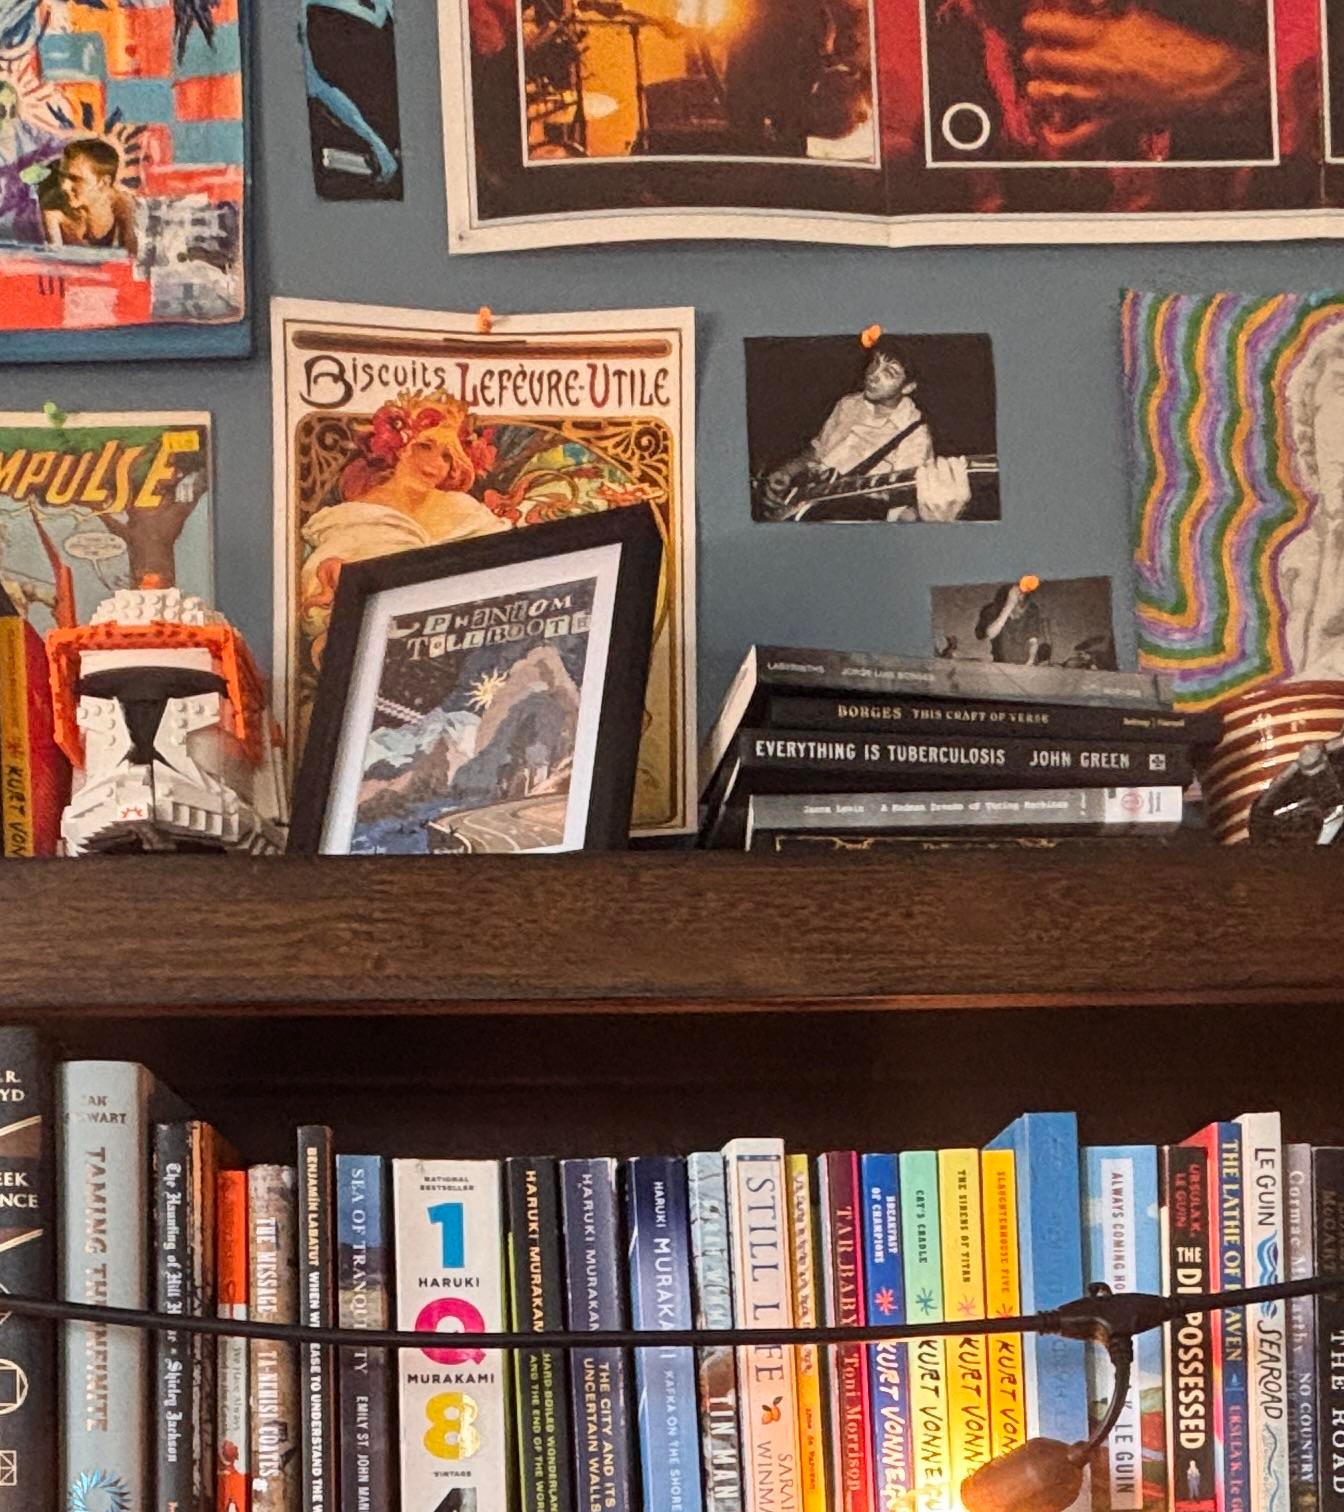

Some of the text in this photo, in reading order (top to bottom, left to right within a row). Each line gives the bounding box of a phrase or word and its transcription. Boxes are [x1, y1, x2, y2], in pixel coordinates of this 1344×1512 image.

[838, 703, 904, 722] BORGES
[913, 709, 943, 721] THIS
[990, 712, 1007, 723] OF
[755, 740, 1132, 769] EVERYTHING IS TUBERCULOSIS JOHN GREEN
[427, 1202, 466, 1269] 1
[746, 1176, 780, 1284] STILL
[418, 1277, 480, 1288] HARUKI
[414, 1297, 486, 1365] Q
[1175, 1246, 1206, 1450] THE DIPOSSESSED
[407, 1373, 495, 1384] MURAKAMI
[1256, 1318, 1284, 1421] SEAROAD
[423, 1391, 481, 1461] 8
